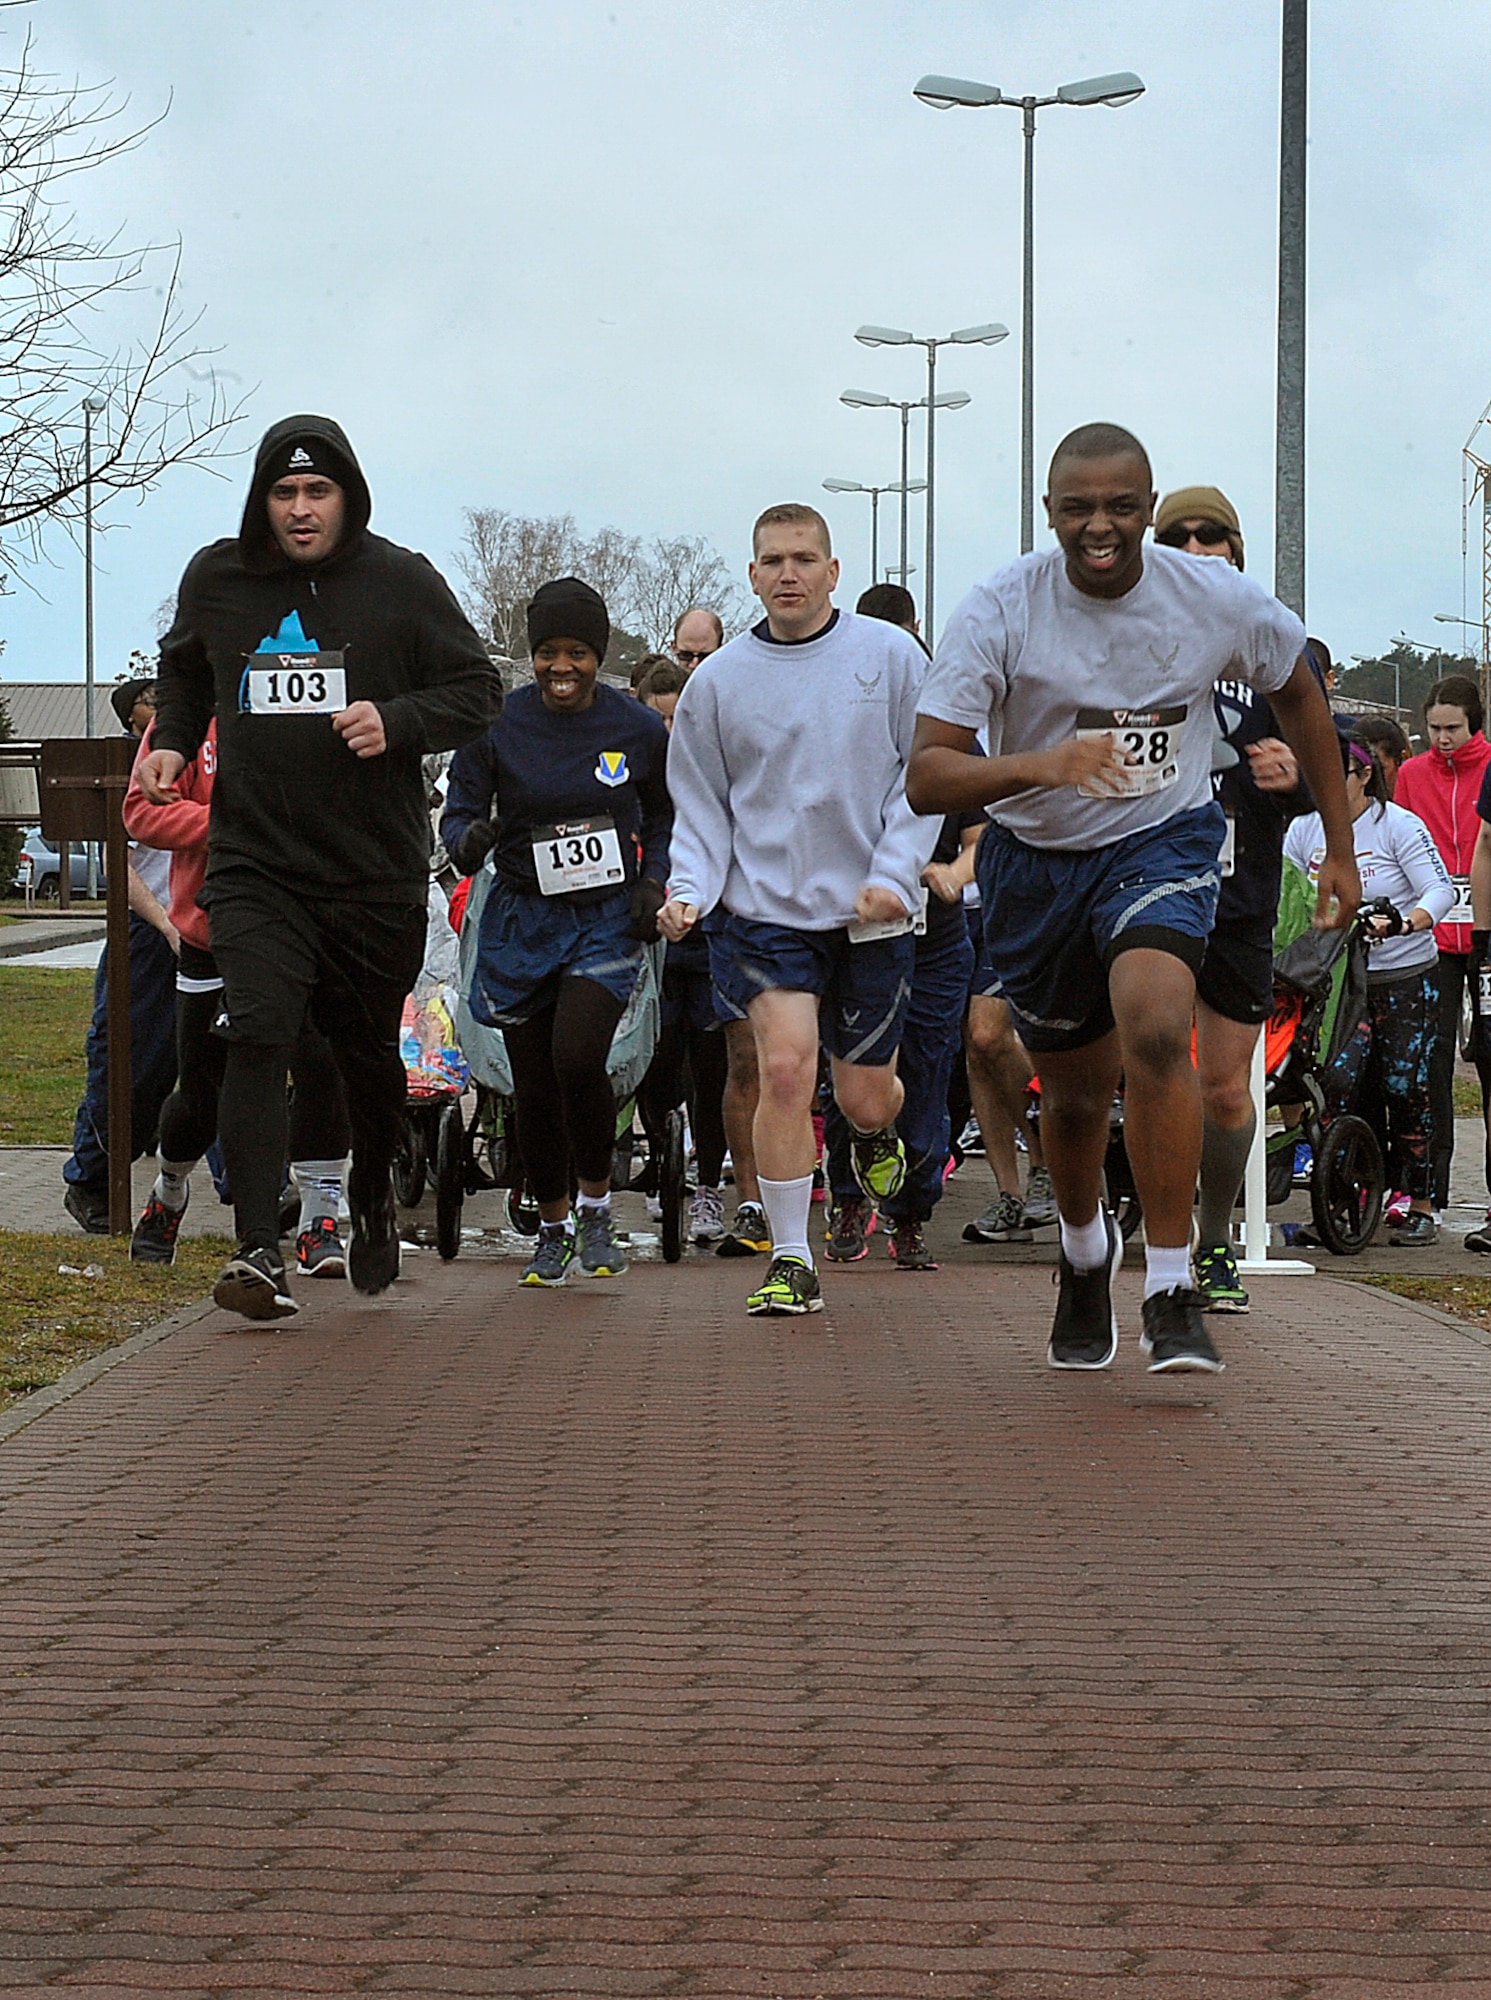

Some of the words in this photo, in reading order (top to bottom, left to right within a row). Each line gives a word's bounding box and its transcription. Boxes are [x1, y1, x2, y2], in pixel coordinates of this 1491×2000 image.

[268, 672, 327, 703] 103
[203, 740, 217, 774] S
[549, 836, 603, 870] 130
